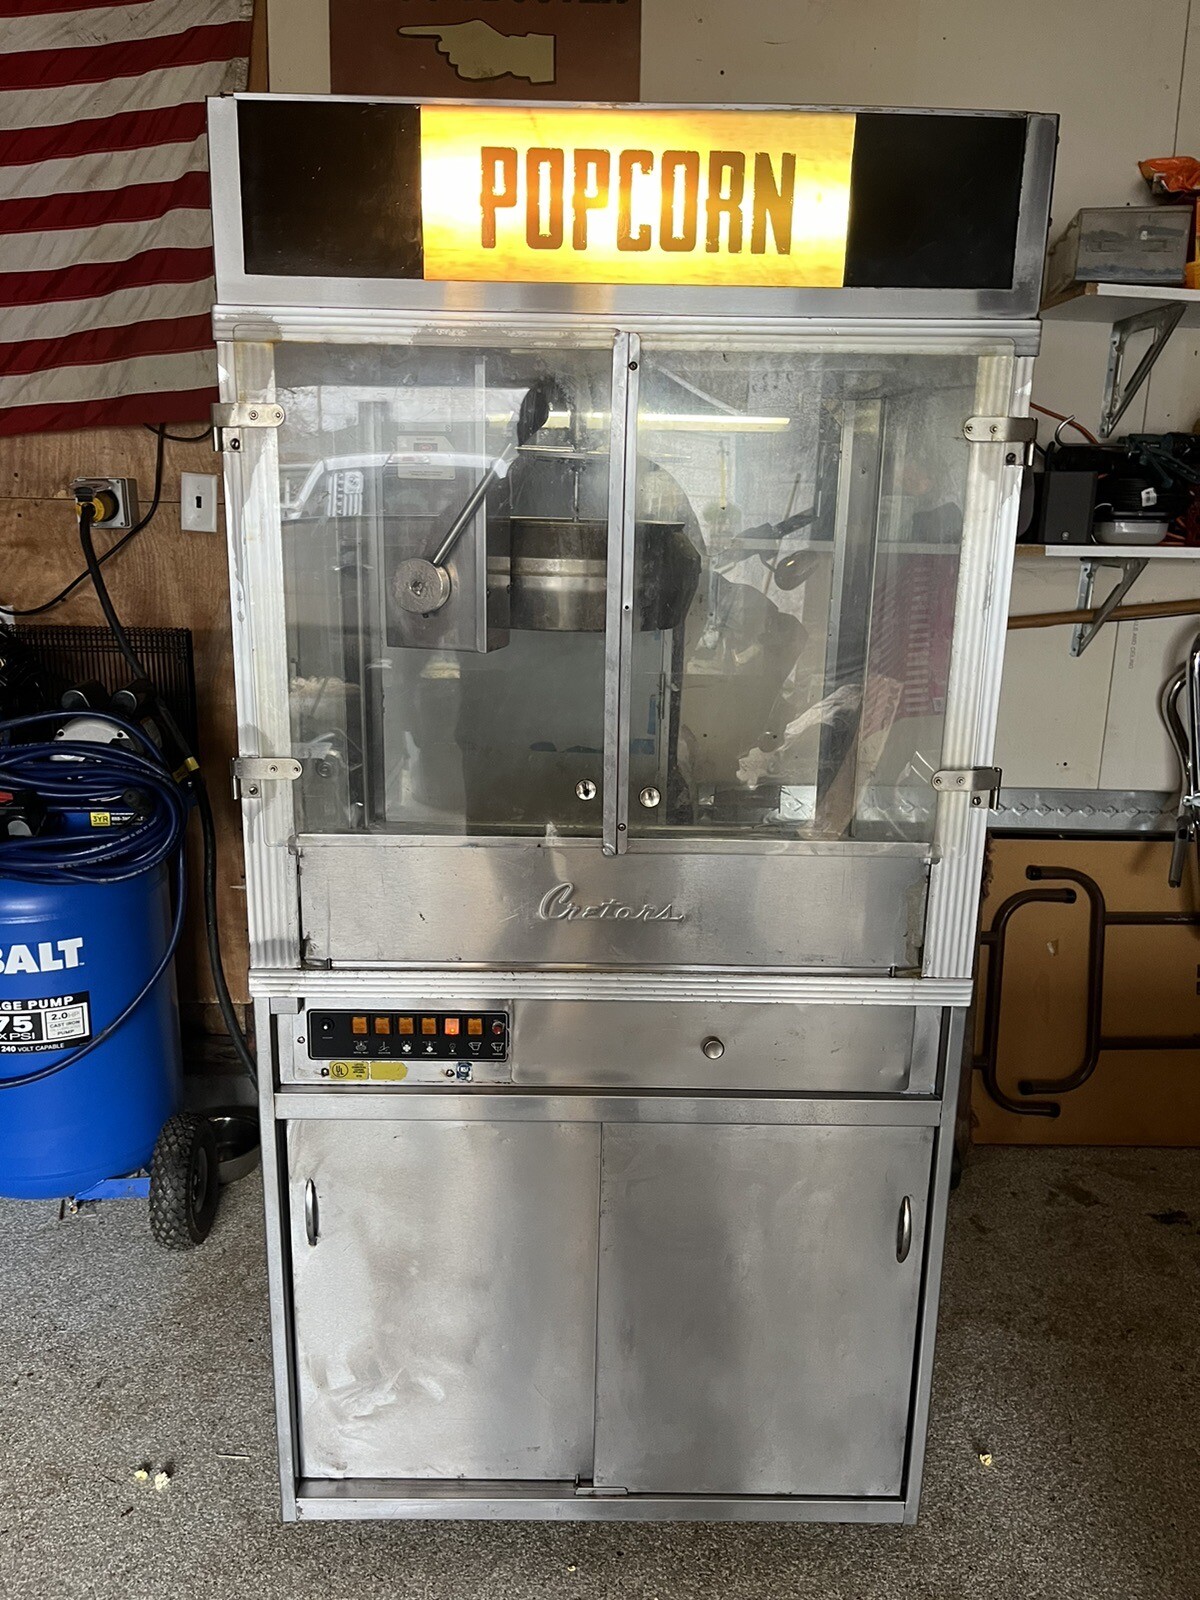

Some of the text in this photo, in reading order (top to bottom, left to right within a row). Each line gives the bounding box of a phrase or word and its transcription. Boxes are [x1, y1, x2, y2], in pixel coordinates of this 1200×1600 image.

[480, 146, 796, 255] POPCORN
[92, 815, 109, 823] 3YR
[539, 882, 685, 921] Cretors
[0, 937, 83, 975] ALT
[0, 996, 74, 1011] GE PUMP
[9, 1032, 36, 1040] PSI
[1, 1045, 16, 1053] 240
[35, 1042, 65, 1051] CAPABLE
